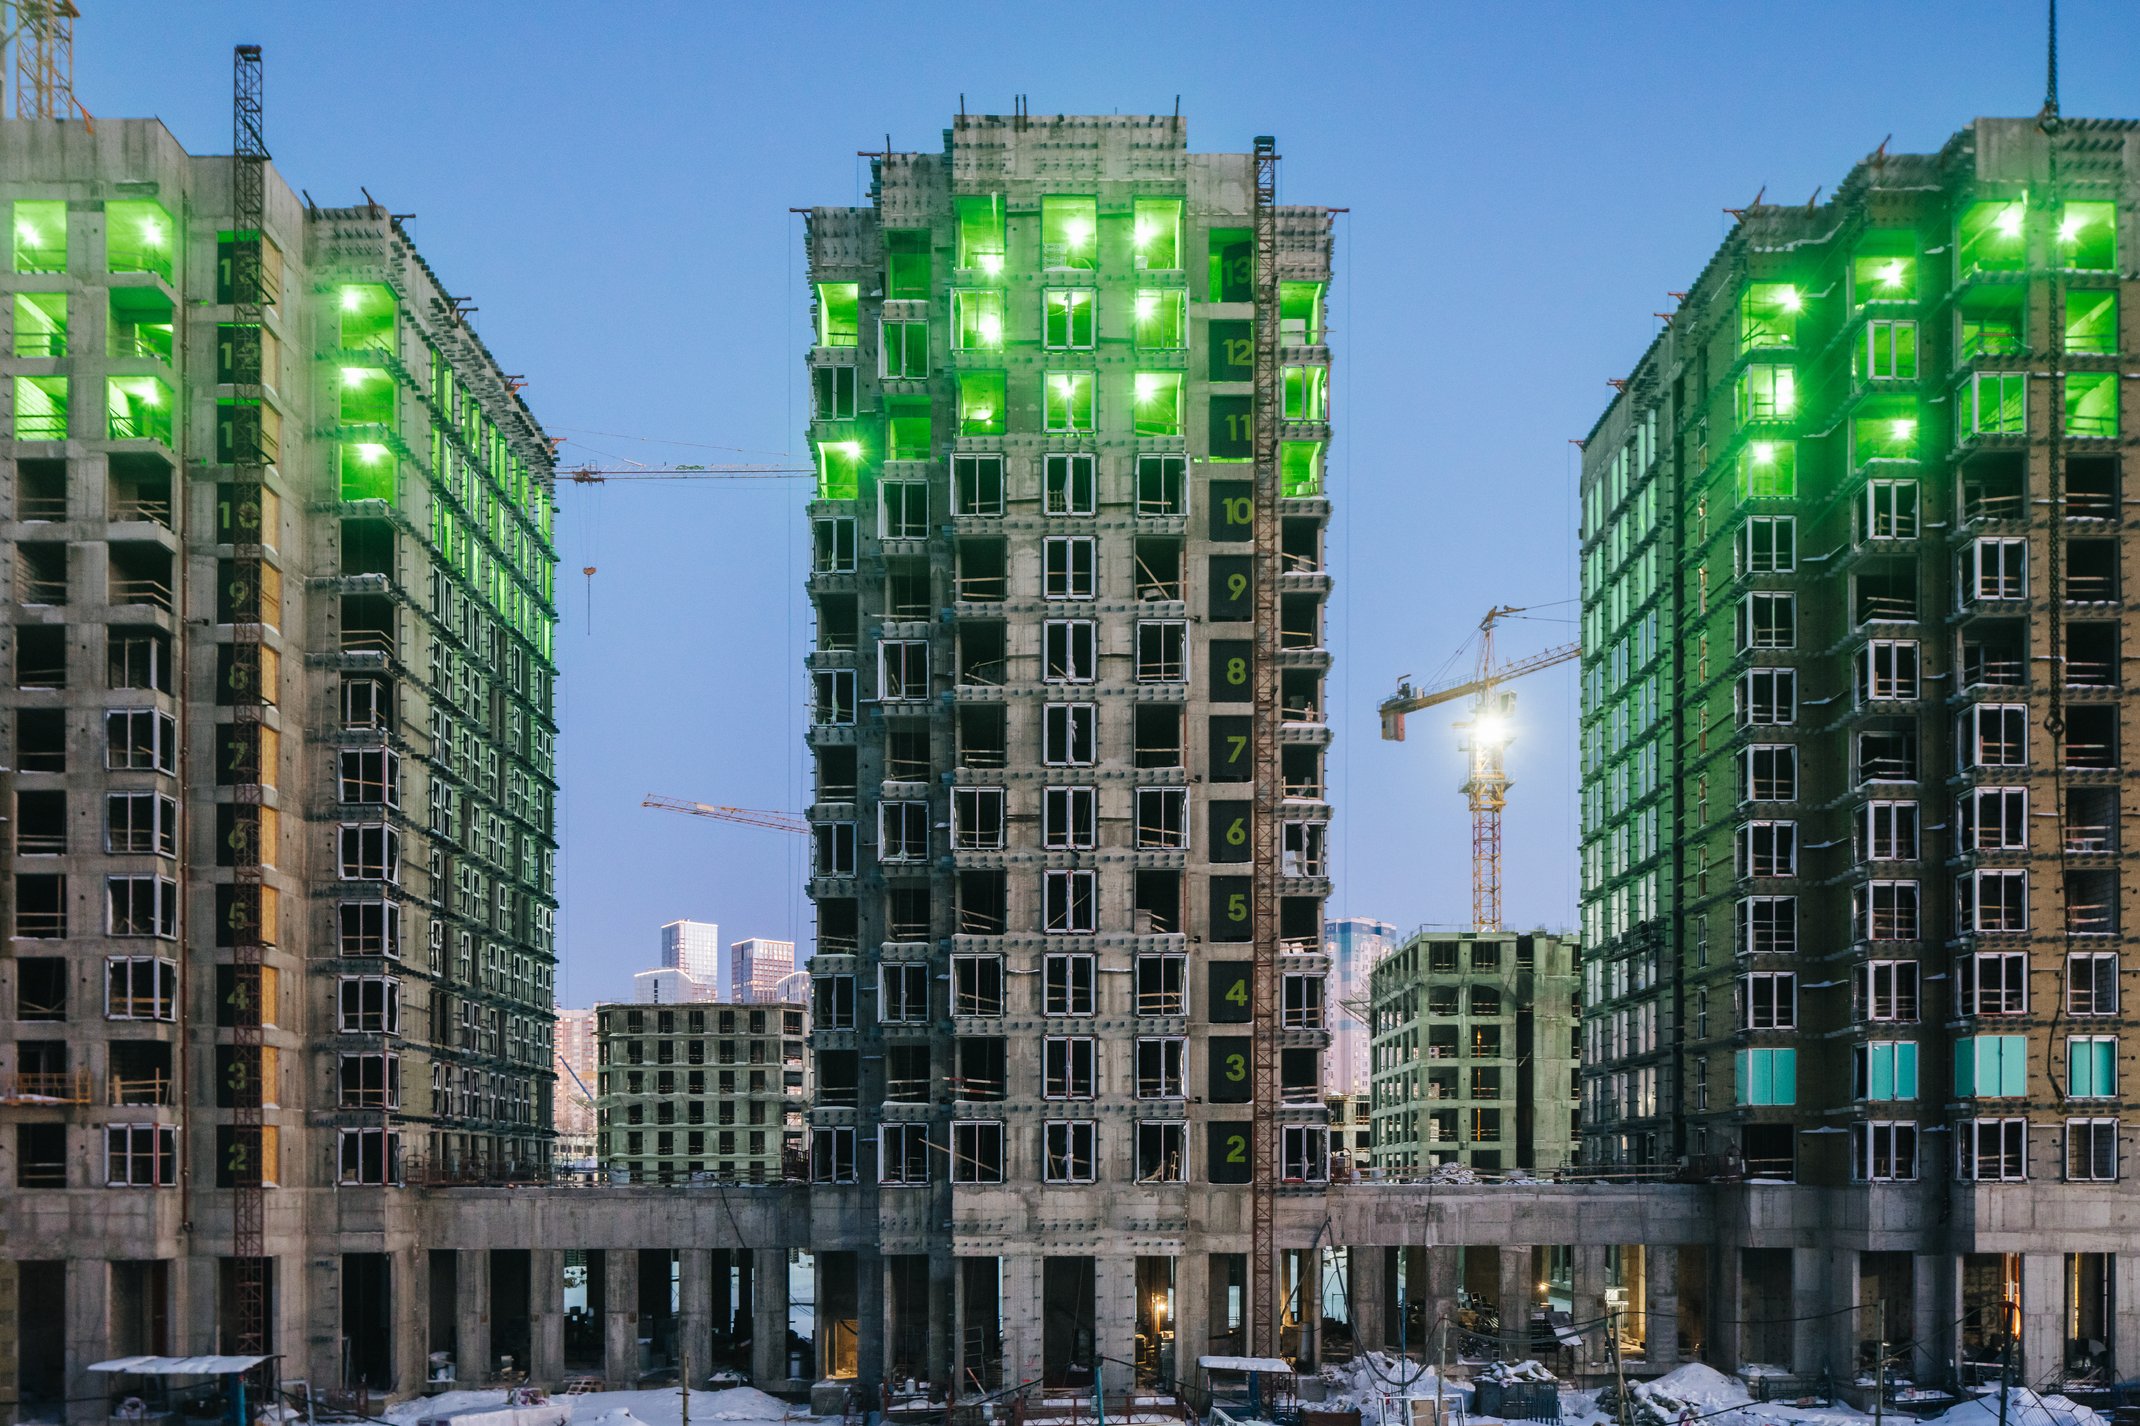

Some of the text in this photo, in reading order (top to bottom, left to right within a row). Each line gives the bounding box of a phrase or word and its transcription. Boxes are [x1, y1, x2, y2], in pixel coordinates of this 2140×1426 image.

[1222, 256, 1252, 287] 13
[1222, 338, 1253, 366] 12
[1225, 414, 1252, 441] 11
[1222, 497, 1253, 525] 10
[1227, 573, 1247, 601] 9
[1227, 657, 1246, 685] 8
[1227, 735, 1247, 763] 7
[1226, 818, 1246, 846] 6
[1228, 893, 1247, 921] 5
[1225, 979, 1248, 1007] 4
[1225, 1053, 1246, 1081] 3
[1226, 1135, 1246, 1163] 2
